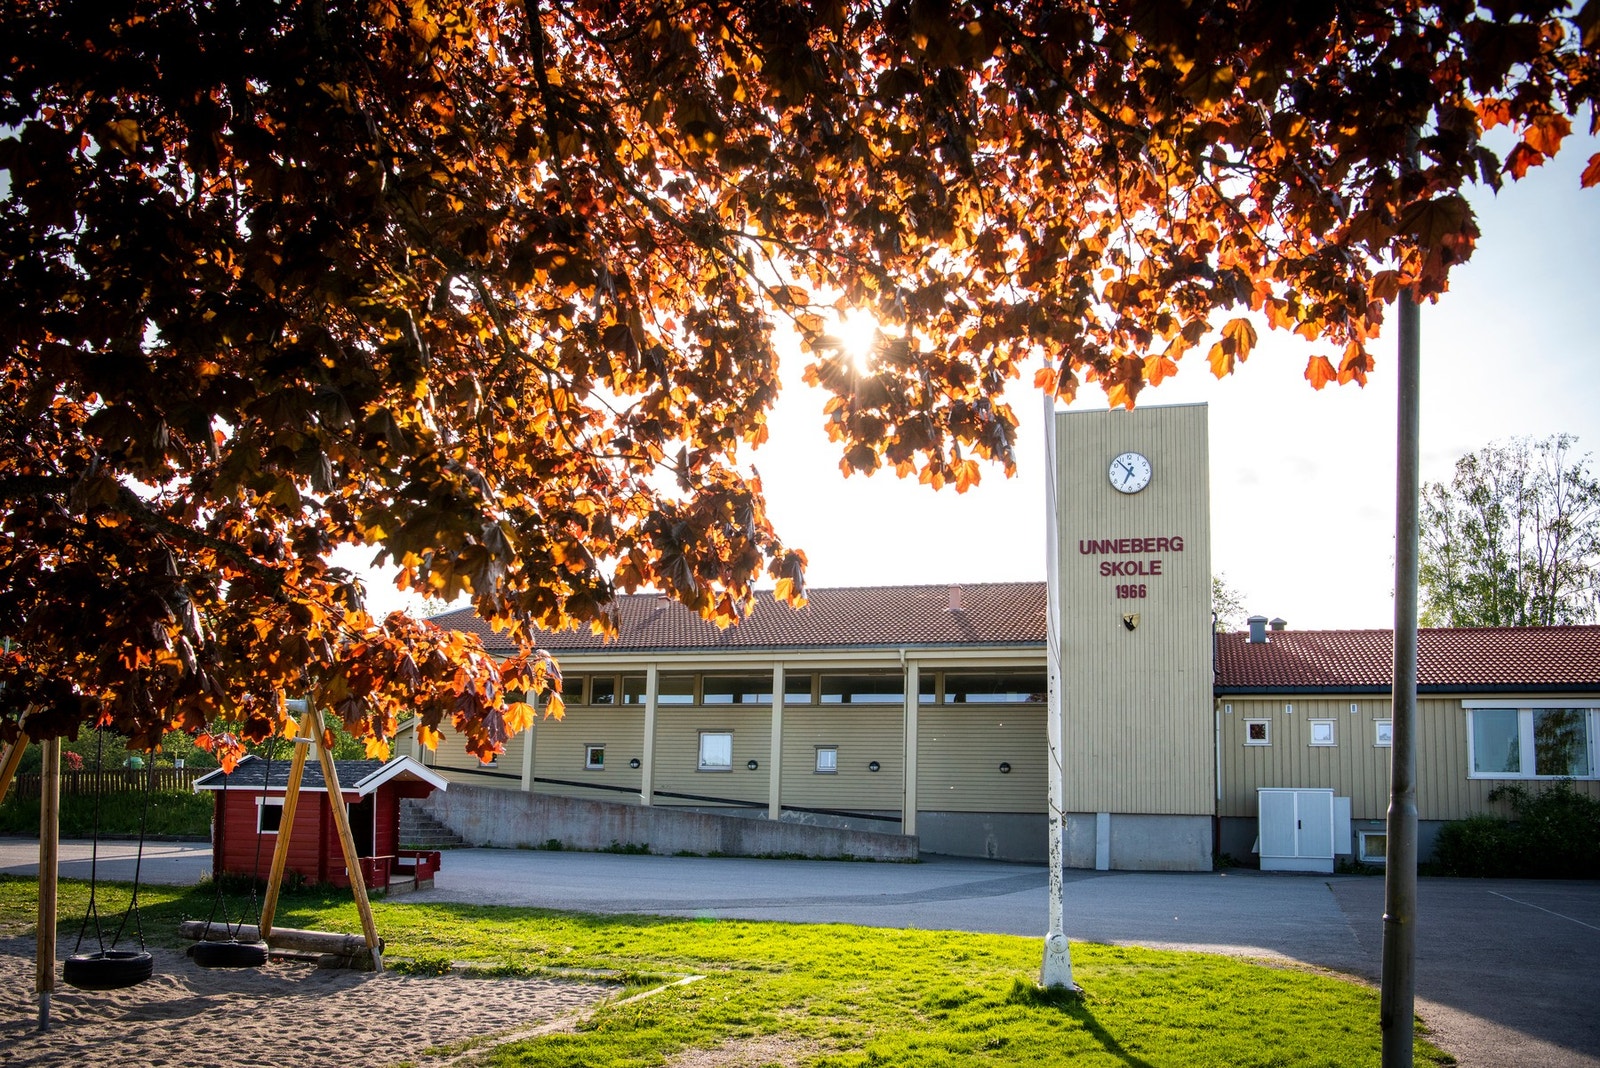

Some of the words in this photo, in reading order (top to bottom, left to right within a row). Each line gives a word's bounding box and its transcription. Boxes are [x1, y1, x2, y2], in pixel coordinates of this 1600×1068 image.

[1079, 536, 1184, 555] UNNEBERG
[1099, 560, 1162, 577] SKOLE
[1115, 584, 1147, 599] 1966
